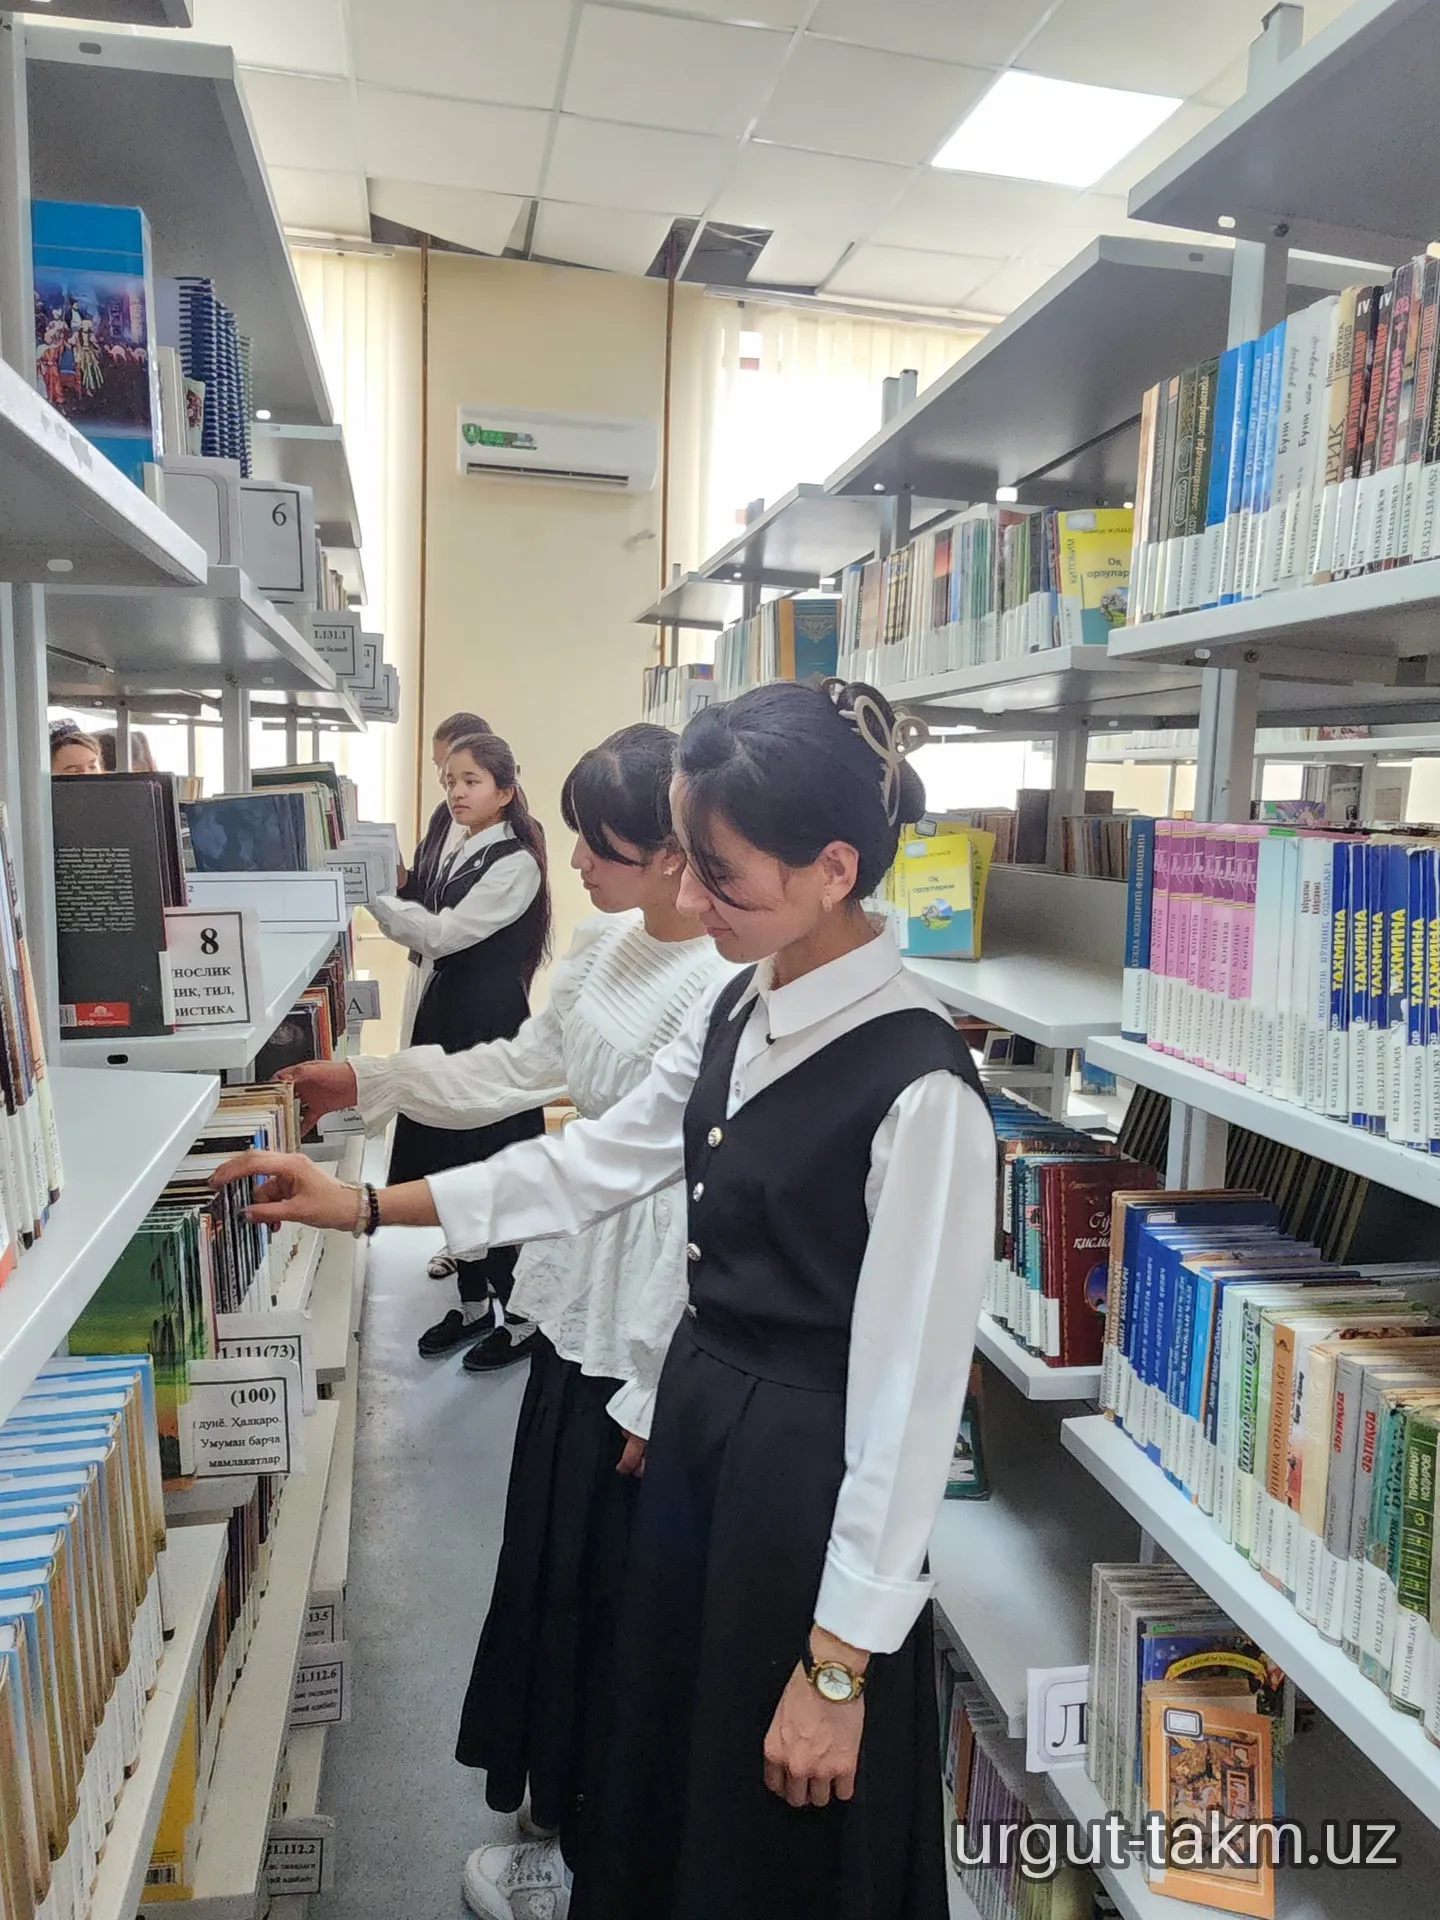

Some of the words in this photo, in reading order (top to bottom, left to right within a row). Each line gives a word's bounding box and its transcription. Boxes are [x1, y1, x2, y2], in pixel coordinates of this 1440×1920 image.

[1278, 421, 1291, 455] Буни
[1298, 413, 1311, 448] Буни
[271, 502, 287, 527] 6
[200, 928, 219, 955] 8
[1332, 909, 1346, 992] ТАХМИНА
[1354, 909, 1368, 993] ТАХМИНА
[1371, 911, 1383, 998] ТАХМИНА
[1390, 909, 1406, 996] ТАХМИНА
[1411, 918, 1425, 1007] ТАХМИНА
[1428, 918, 1440, 1008] ТАХМИНА
[203, 986, 235, 997] ТИЛ,
[347, 996, 364, 1016] А
[230, 1387, 276, 1408] (100)
[199, 1418, 228, 1431] дунё.
[200, 1437, 245, 1450] Умуман
[249, 1435, 281, 1447] барча
[208, 1455, 281, 1468] мамлакатлар
[1051, 1702, 1088, 1748] Л
